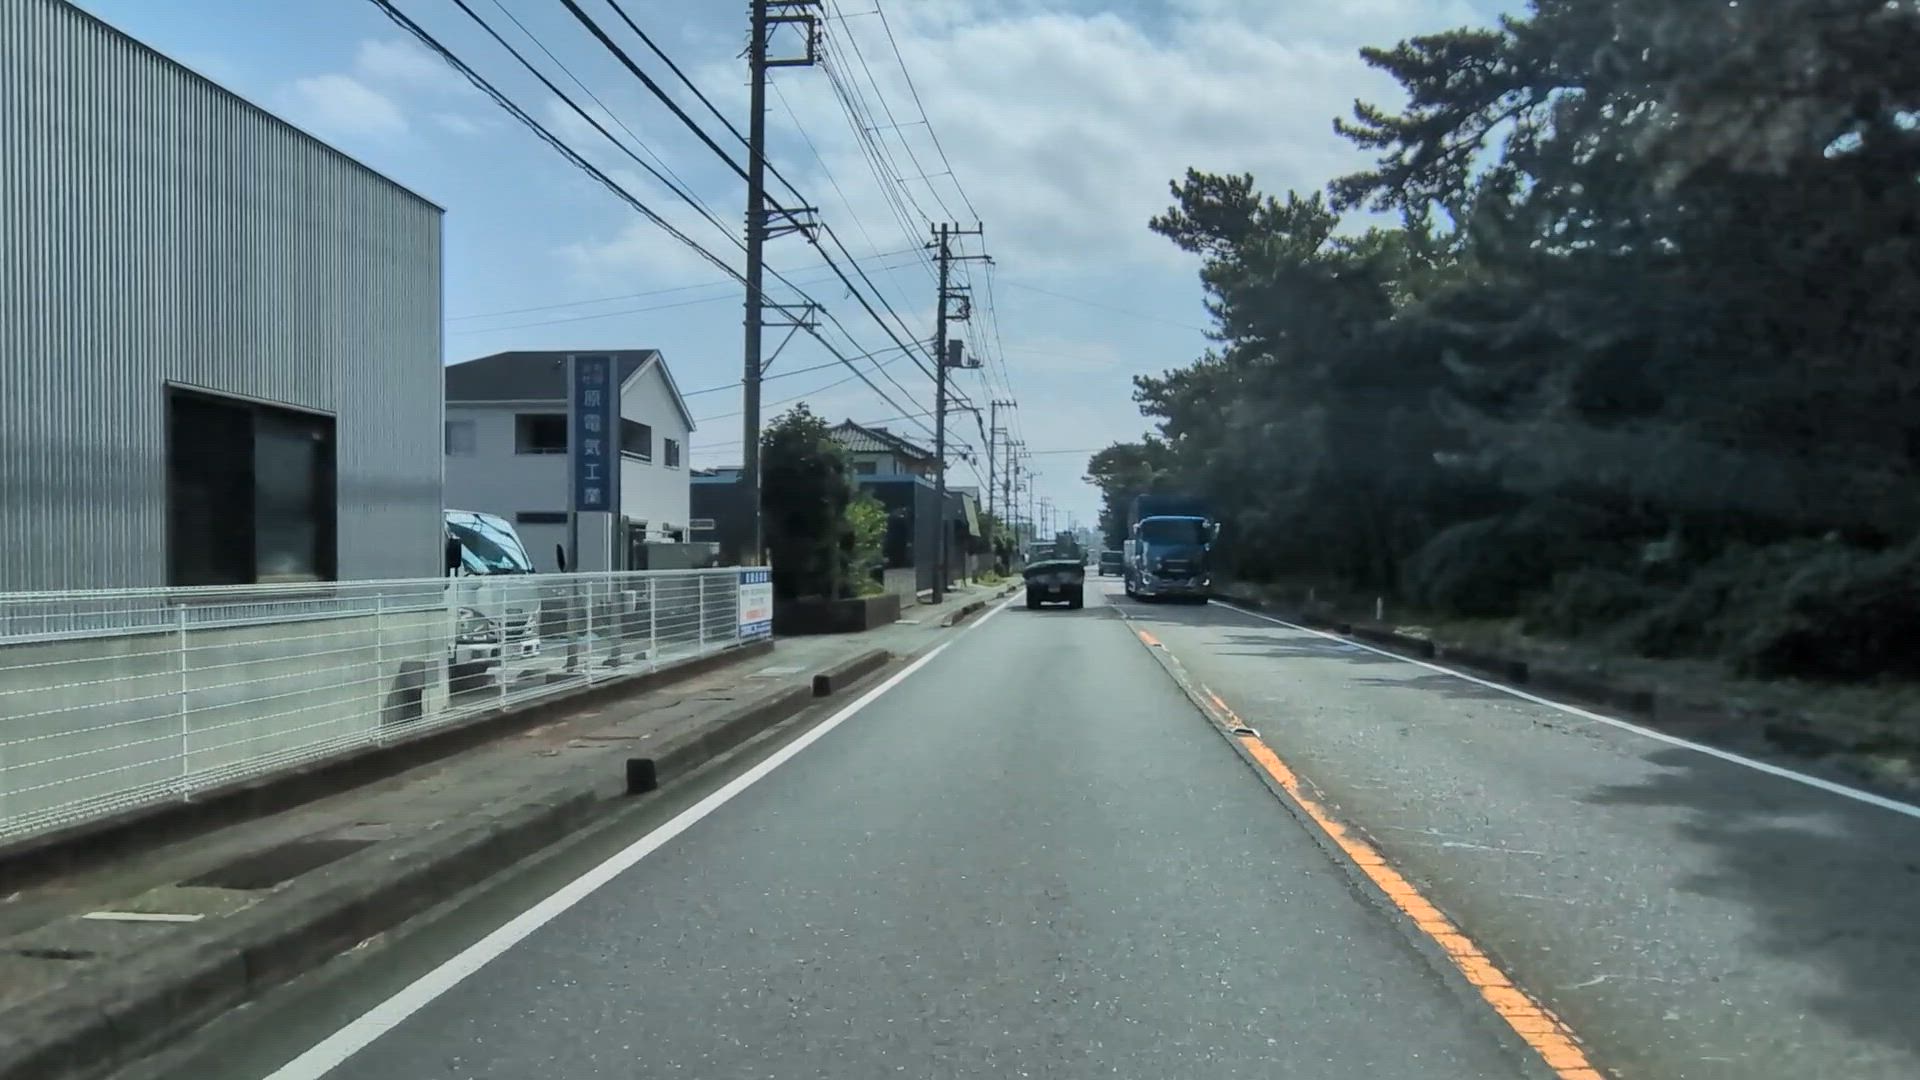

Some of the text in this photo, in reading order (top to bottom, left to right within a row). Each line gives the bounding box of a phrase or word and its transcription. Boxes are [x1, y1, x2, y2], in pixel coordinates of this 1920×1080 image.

[584, 390, 601, 505] 原電気工業
